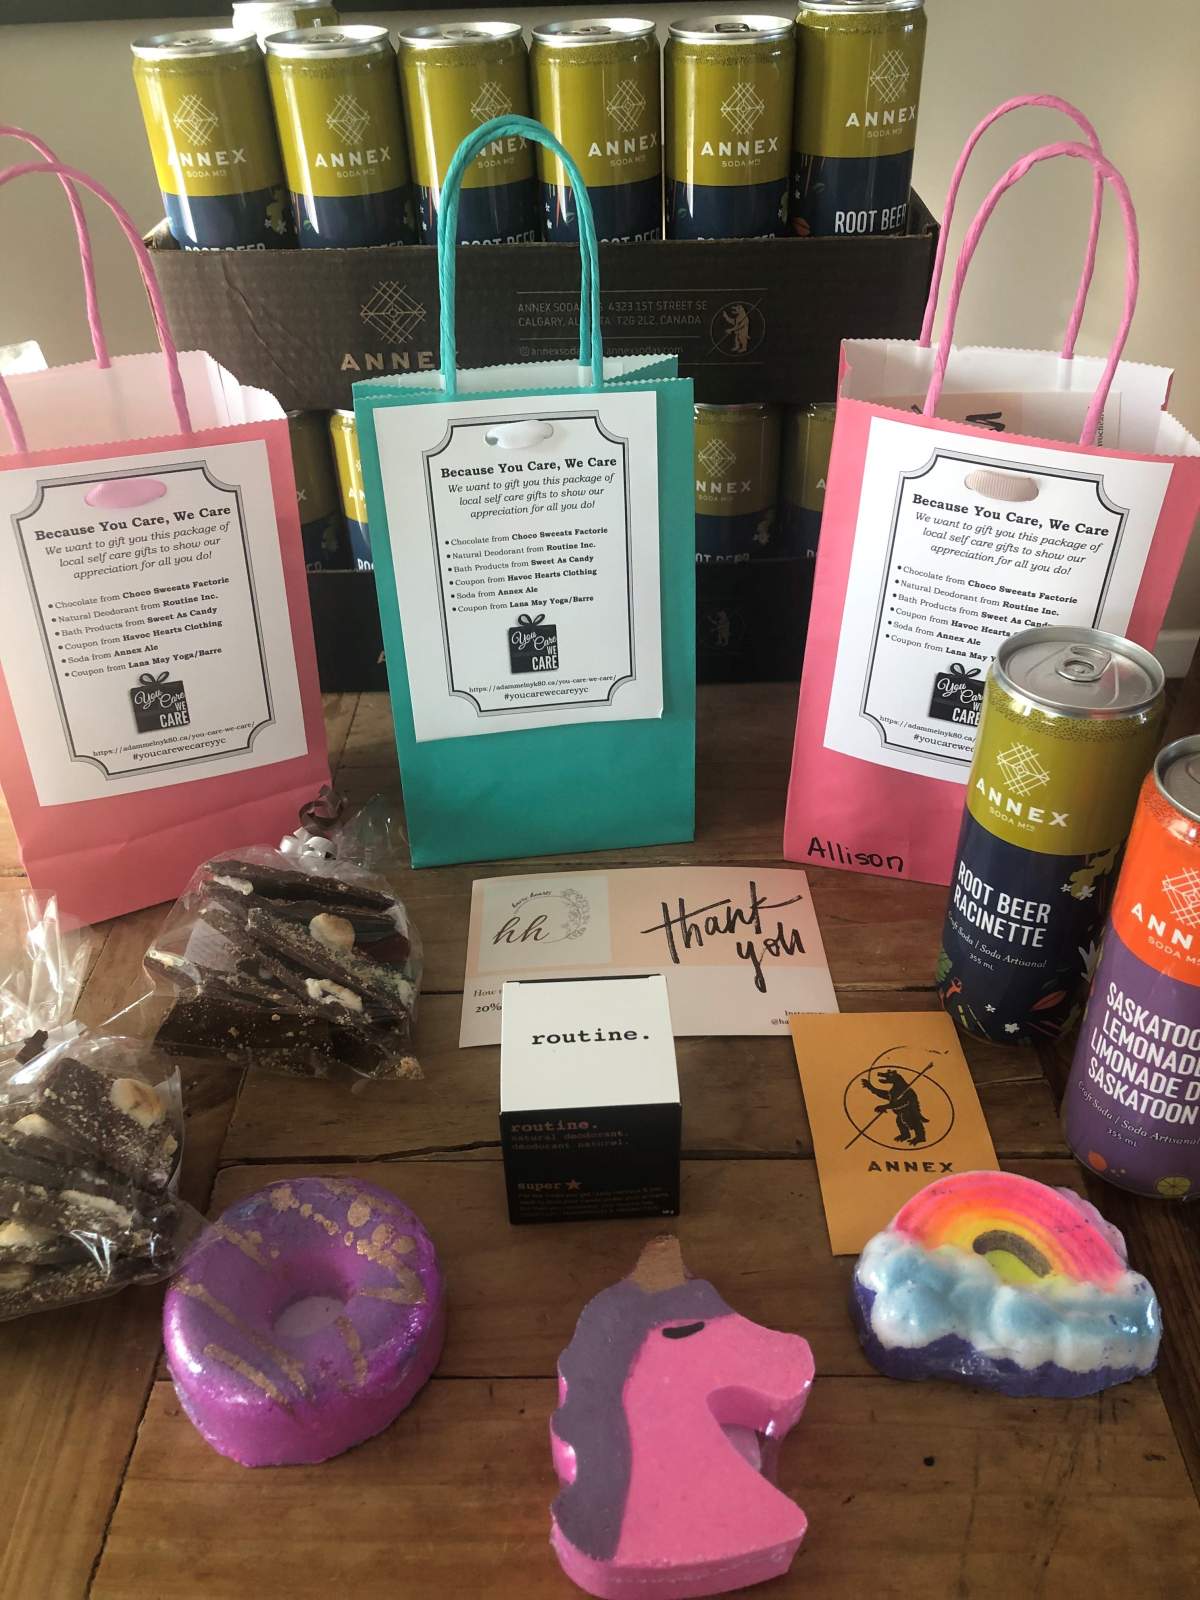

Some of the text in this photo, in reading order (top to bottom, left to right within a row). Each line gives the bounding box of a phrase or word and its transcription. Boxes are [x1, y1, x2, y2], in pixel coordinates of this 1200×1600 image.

[845, 105, 917, 128] ANNEX
[475, 136, 528, 157] NEX
[587, 132, 657, 157] ANNEX
[700, 137, 778, 156] ANNEX
[314, 147, 392, 168] ANNEX
[834, 210, 878, 234] ROOT
[518, 302, 579, 313] ANNEX SODA
[656, 300, 694, 310] STREET
[695, 300, 708, 310] SE
[659, 315, 701, 326] CANADA
[340, 350, 439, 371] ANNE
[440, 457, 617, 478] Because You Care, We Care
[448, 472, 616, 493] We want to gift you this package of
[695, 480, 751, 494] NNEX
[459, 488, 605, 506] local self care gifts to show our
[470, 500, 595, 520] appreciation for all you do!
[912, 493, 1109, 537] Because You Care, We Care
[34, 507, 231, 541] Because You Care, We Care
[450, 537, 490, 546] Chocolate
[491, 535, 510, 543] from
[511, 533, 538, 541] Choco
[574, 527, 608, 536] Factorie
[452, 550, 482, 560] Natural
[484, 547, 525, 557] Deodorant
[526, 545, 544, 553] from
[546, 543, 578, 551] Routine
[930, 545, 1072, 575] appreciation for all you do!
[453, 564, 473, 573] Bath
[474, 562, 509, 571] Products
[511, 560, 529, 568] from
[530, 558, 555, 566] Sweet
[568, 554, 594, 563] Candy
[454, 568, 597, 587] Coupon from Havoc Hearts Clothing
[903, 566, 943, 581] Chocolate
[945, 575, 965, 585] from
[967, 579, 997, 591] Choco
[1038, 592, 1078, 604] Factorie
[456, 586, 538, 599] Soda from Annex Ale
[457, 605, 488, 613] Coupon
[489, 602, 508, 610] from
[531, 599, 548, 607] May
[549, 596, 594, 605] Yoga/Barre
[511, 631, 557, 651] You Care
[546, 645, 558, 655] WE
[532, 655, 558, 671] CARE
[504, 686, 589, 701] #youcarewecareyyc
[159, 712, 189, 728] CARE
[976, 777, 1070, 828] ANNEX
[989, 806, 1015, 825] SODA
[807, 836, 904, 873] Allison
[958, 860, 1052, 924] ROOT BEER
[640, 880, 804, 965] thank
[953, 884, 1047, 948] RACINETTE
[736, 921, 806, 993] you
[957, 926, 974, 946] Soda
[980, 944, 1002, 960] Soda
[1002, 954, 1048, 969] Artisanal
[969, 952, 982, 965] 355
[475, 1003, 502, 1013] 20%
[532, 1028, 650, 1045] routine.
[1090, 1026, 1183, 1099] LIMONADE
[1088, 1056, 1199, 1125] SASKATOON
[1093, 1098, 1113, 1120] Soda
[1121, 1119, 1148, 1137] Soda
[867, 1160, 953, 1173] ANNEX
